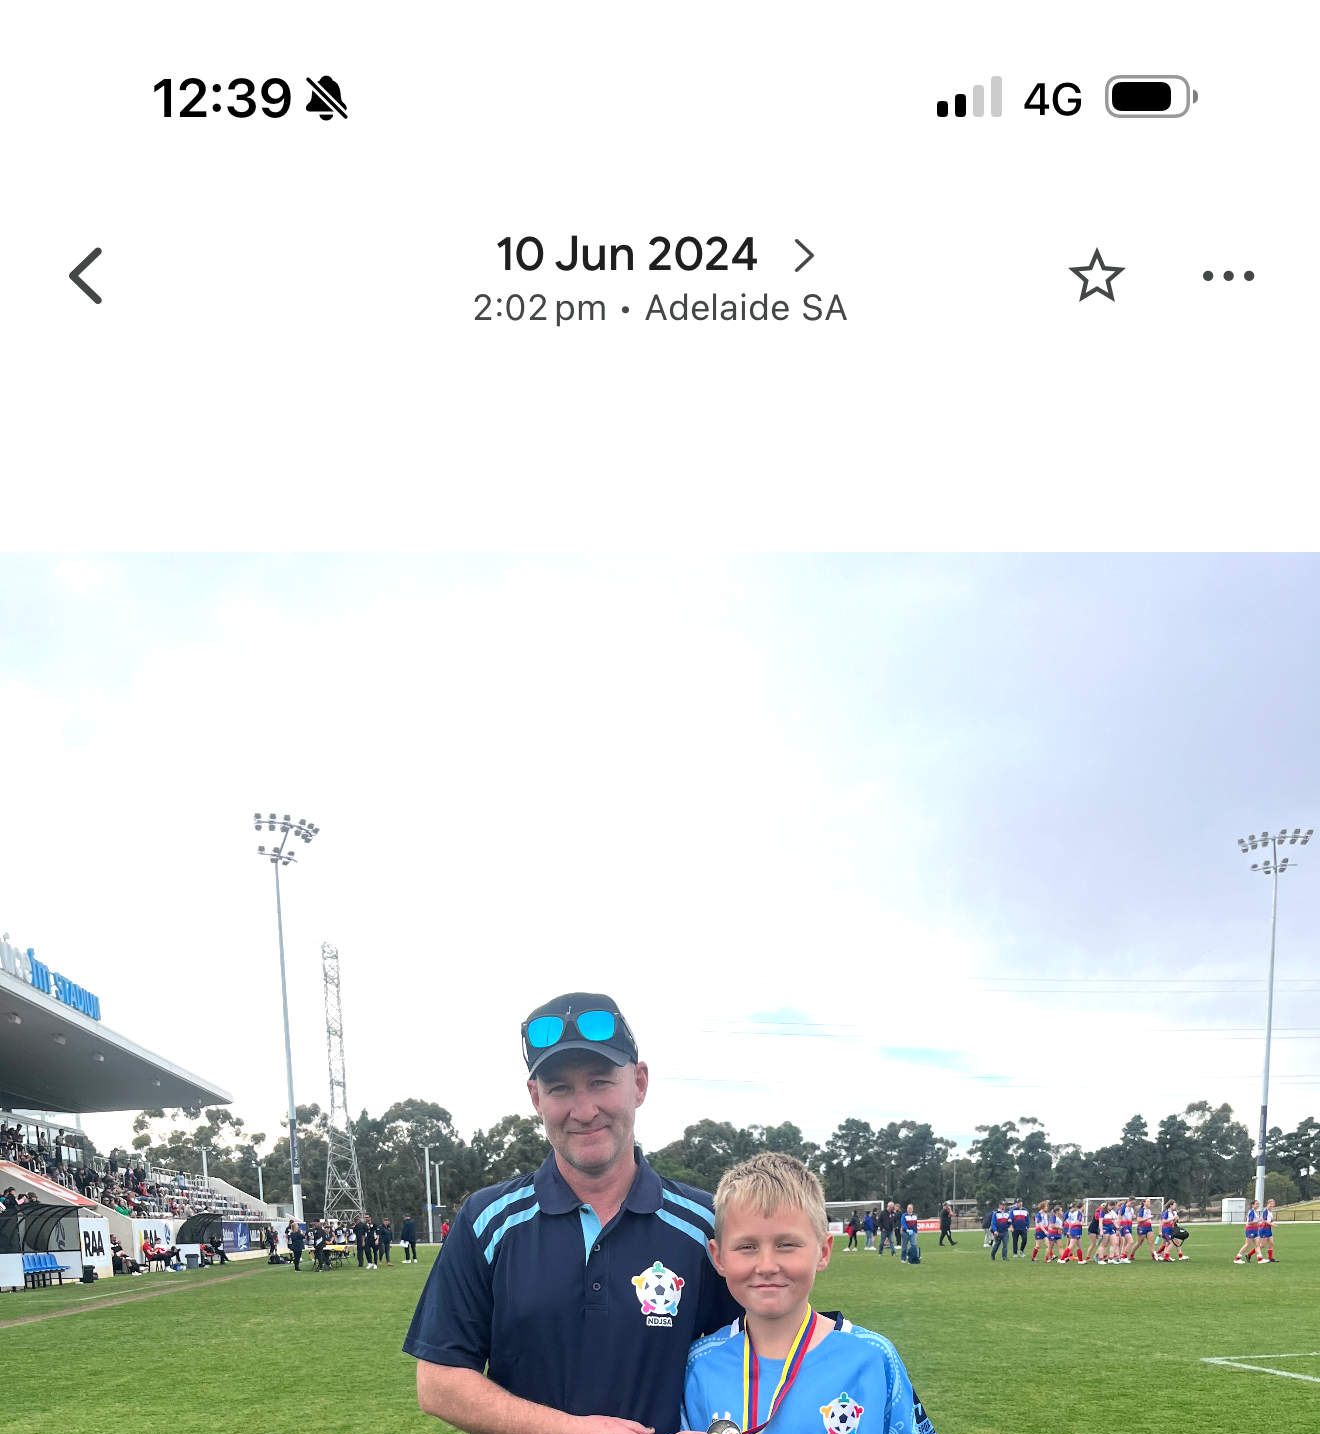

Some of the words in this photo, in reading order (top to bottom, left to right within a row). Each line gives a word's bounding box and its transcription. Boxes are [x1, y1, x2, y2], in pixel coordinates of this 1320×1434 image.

[53, 971, 101, 1022] STADIUM
[83, 1230, 105, 1258] RAA
[646, 1316, 673, 1327] NDJSA
